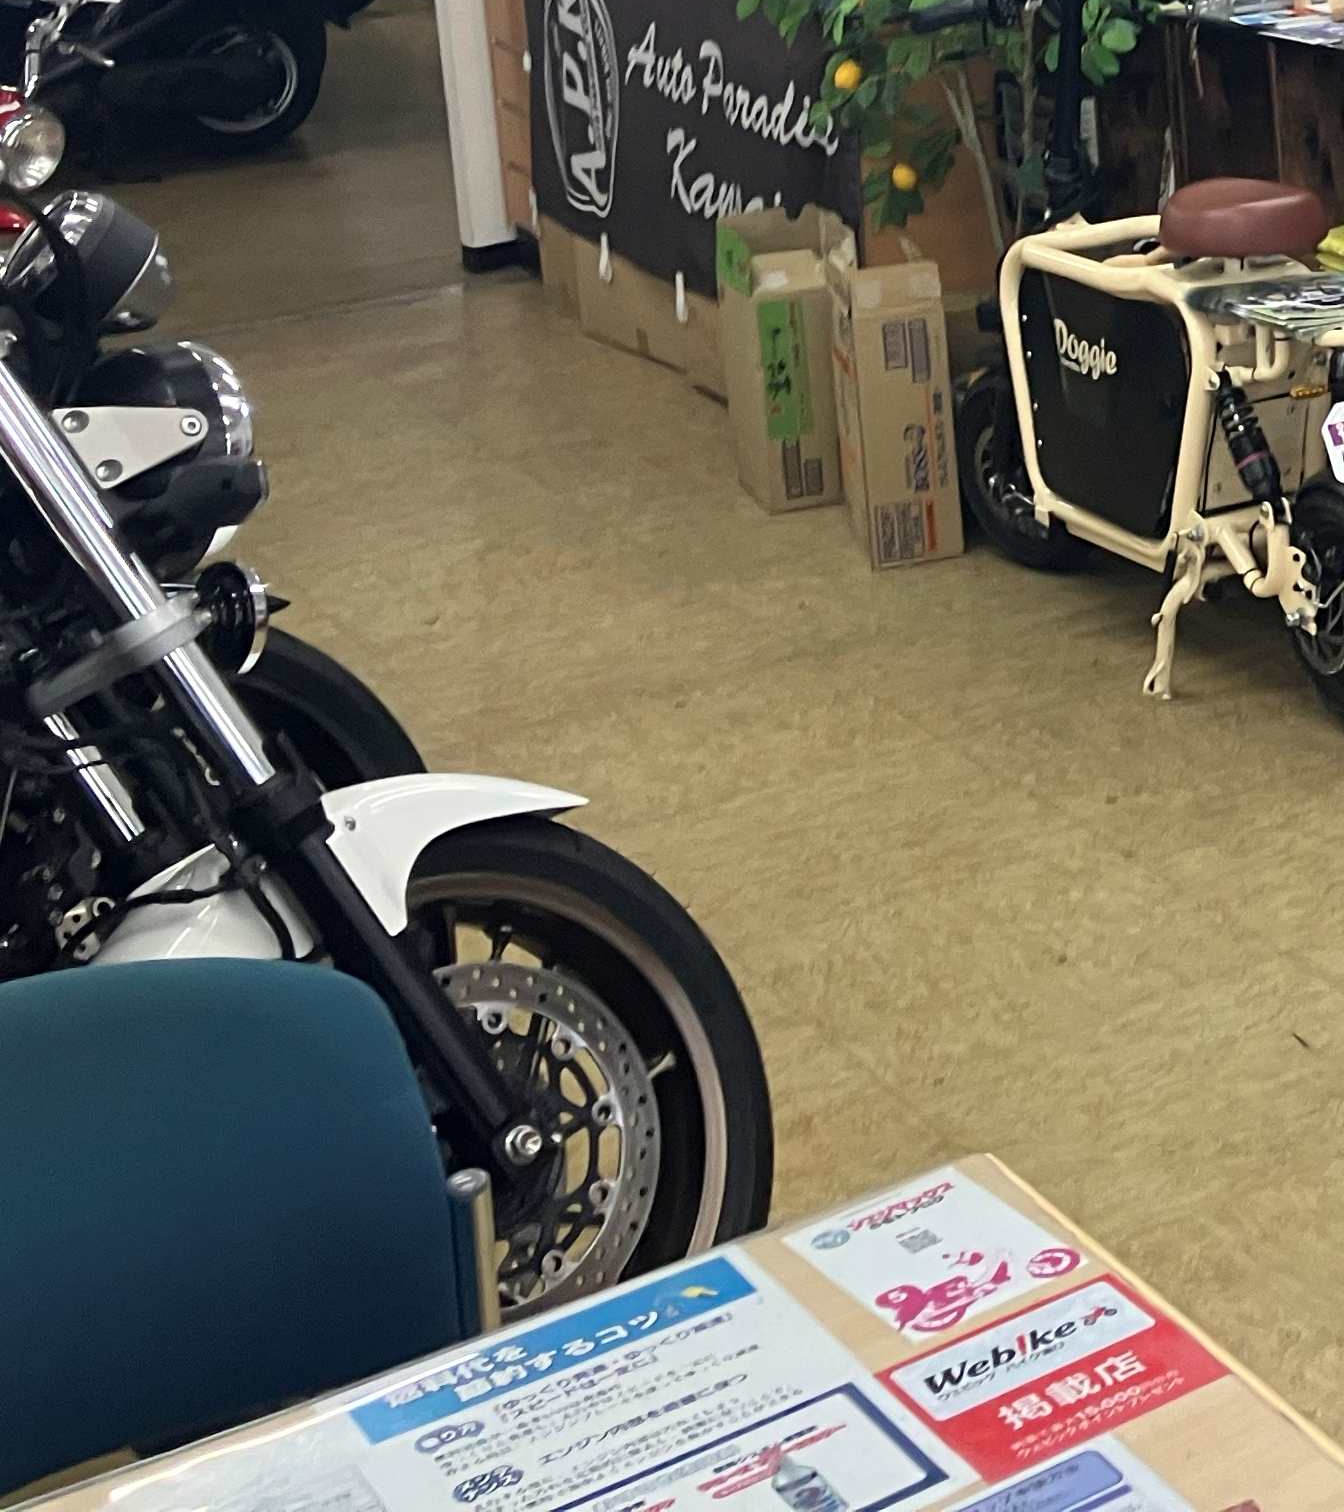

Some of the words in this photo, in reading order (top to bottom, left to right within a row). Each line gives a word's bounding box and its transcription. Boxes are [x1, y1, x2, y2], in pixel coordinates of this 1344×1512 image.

[625, 21, 696, 104] Auto
[1054, 318, 1117, 380] Doggie
[454, 1311, 659, 1402] 節約するコツ
[998, 1350, 1147, 1430] 掲載店
